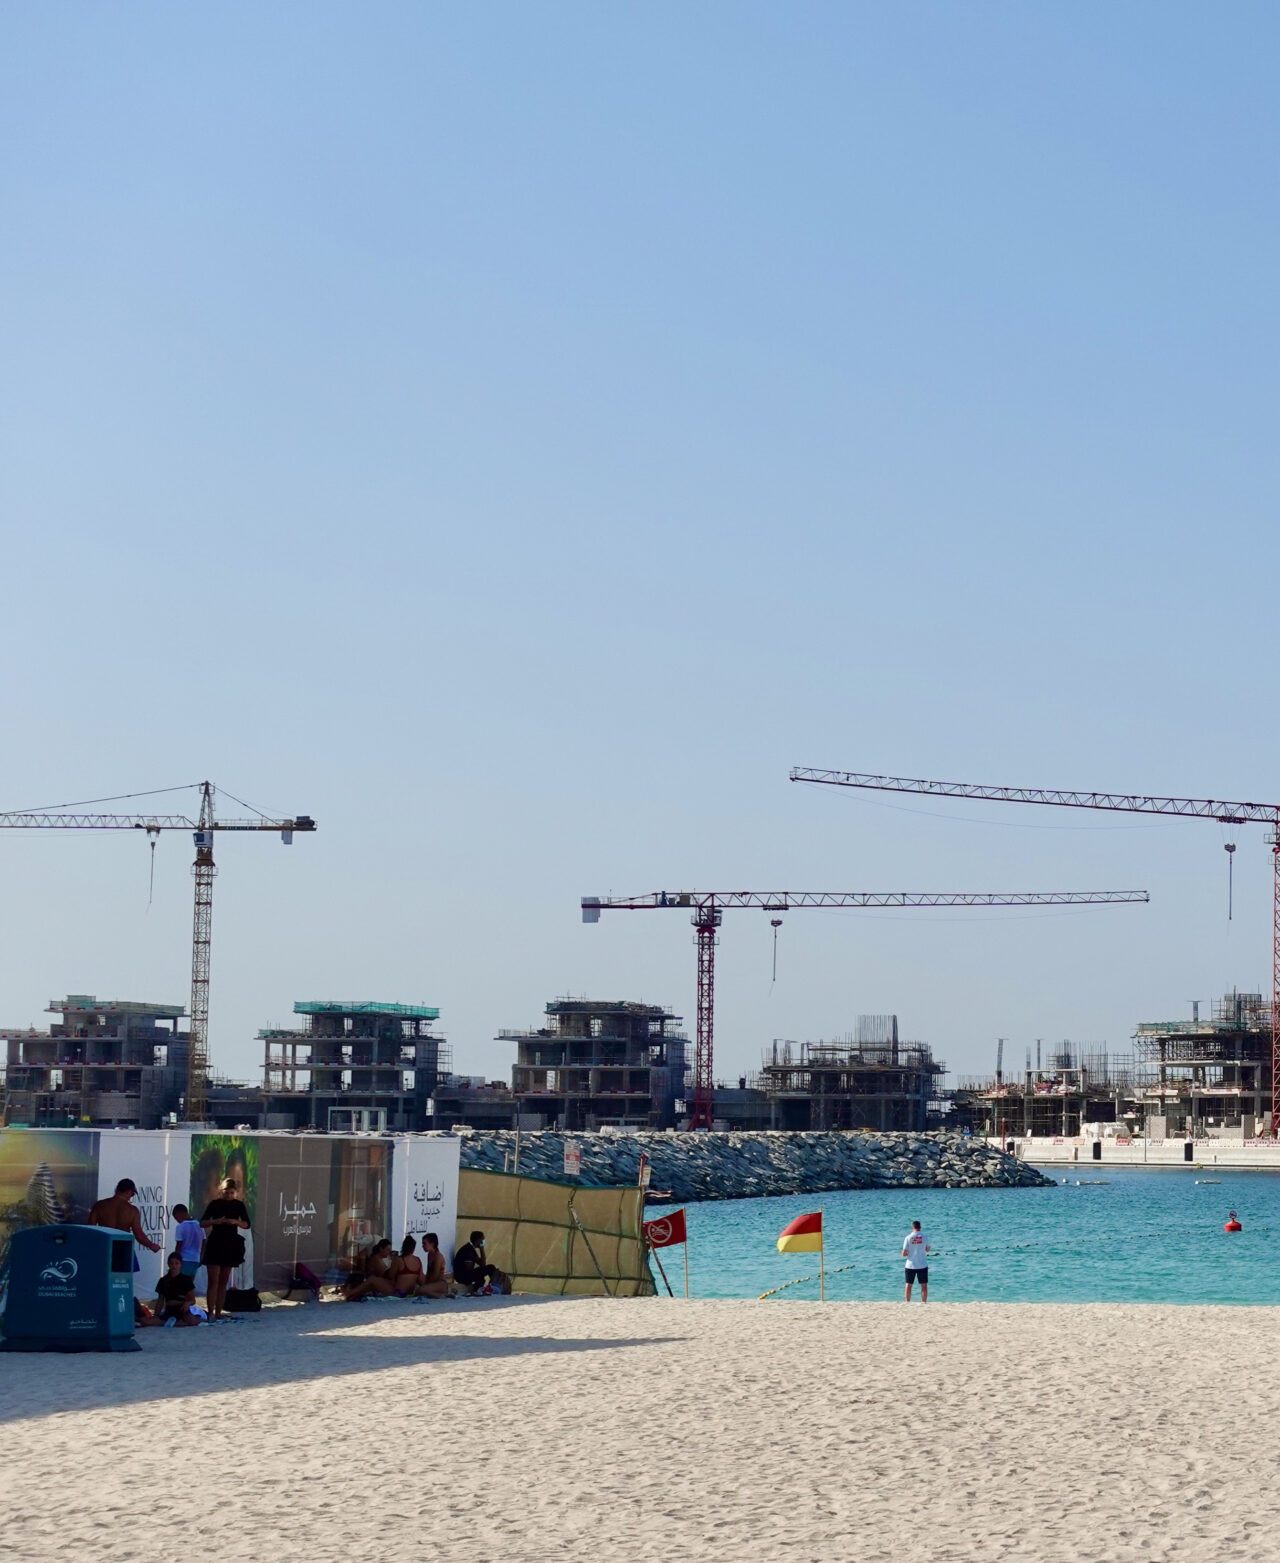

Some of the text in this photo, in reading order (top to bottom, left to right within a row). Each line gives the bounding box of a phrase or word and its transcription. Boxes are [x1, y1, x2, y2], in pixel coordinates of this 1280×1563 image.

[414, 1179, 444, 1207] إضافة
[139, 1206, 173, 1230] XURY
[421, 1204, 440, 1219] جديدة
[139, 1233, 166, 1250] OTEL
